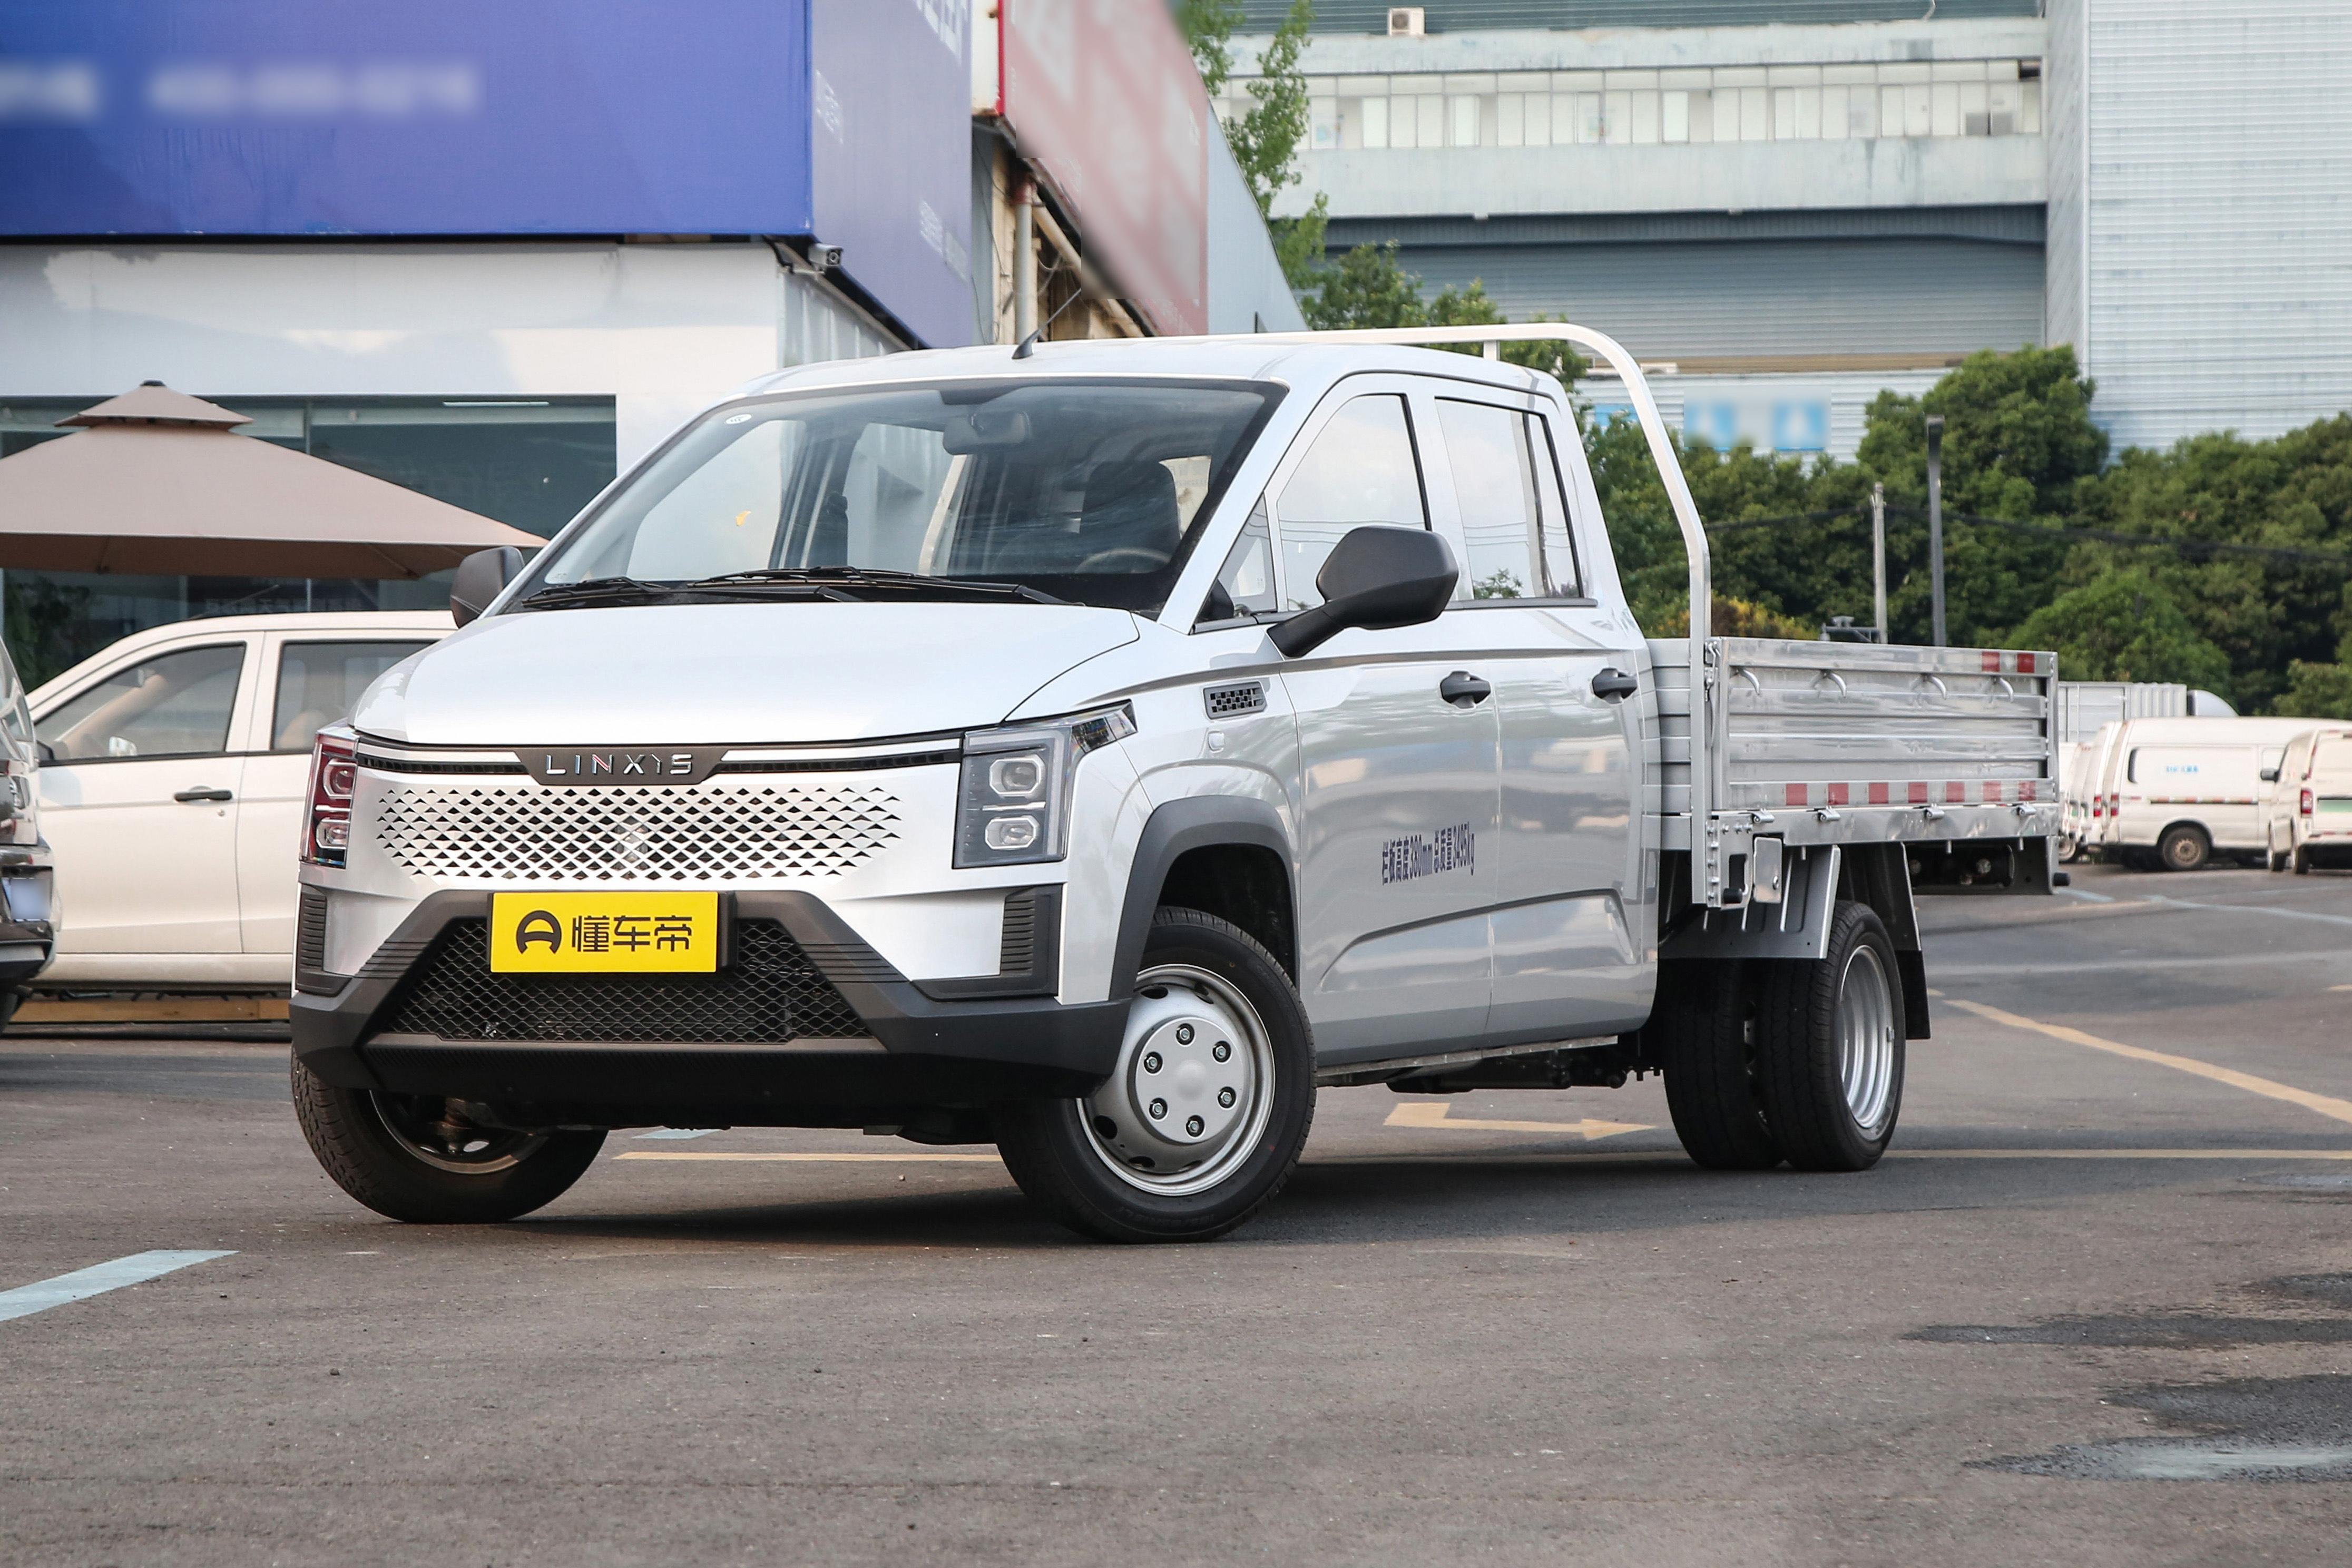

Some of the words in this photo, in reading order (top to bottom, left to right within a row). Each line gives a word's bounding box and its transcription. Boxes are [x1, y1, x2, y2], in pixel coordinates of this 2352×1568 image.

[545, 753, 692, 775] LINXYS
[1381, 834, 1433, 886] 栏板高度380mm
[1434, 821, 1475, 876] 总质量3495kg
[572, 915, 692, 952] 懂车帝
